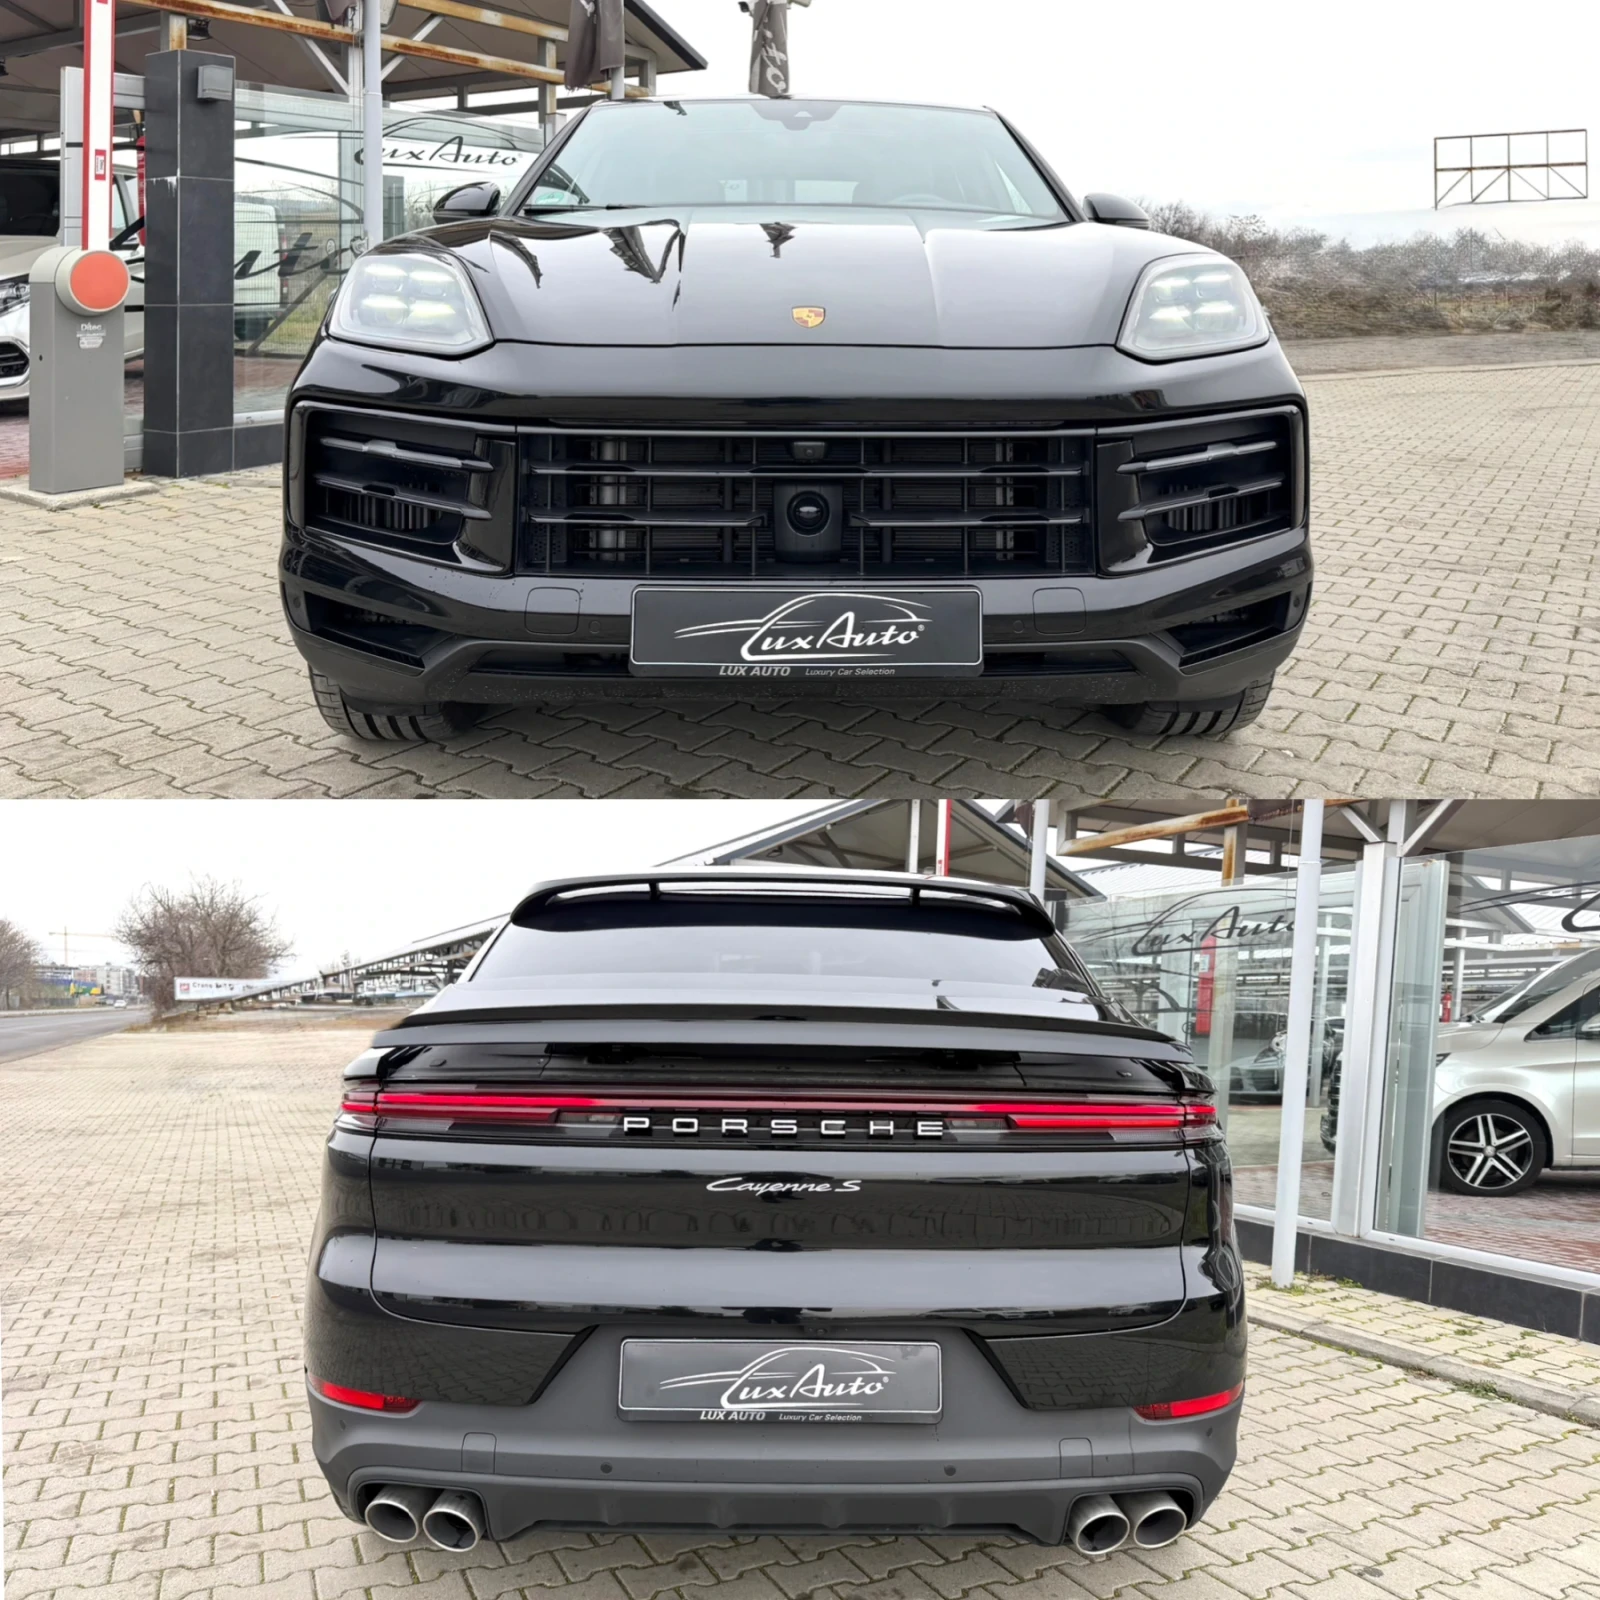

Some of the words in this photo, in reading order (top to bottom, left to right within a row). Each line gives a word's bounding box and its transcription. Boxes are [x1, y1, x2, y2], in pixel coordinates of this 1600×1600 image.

[428, 135, 518, 166] Auto
[740, 618, 815, 661] Lux
[719, 665, 747, 677] LUX
[749, 665, 791, 677] AUTO
[804, 667, 836, 678] Luxury
[837, 667, 854, 676] Car
[855, 666, 896, 677] Selection
[623, 1116, 944, 1137] PORSCHE
[706, 1177, 833, 1196] Cayenne
[834, 1179, 862, 1193] S
[720, 1371, 789, 1409] Lux
[700, 1410, 726, 1421] LUX
[727, 1410, 766, 1422] AUTO
[778, 1412, 807, 1422] Luxury
[808, 1412, 824, 1422] Car
[824, 1413, 862, 1422] Selection
